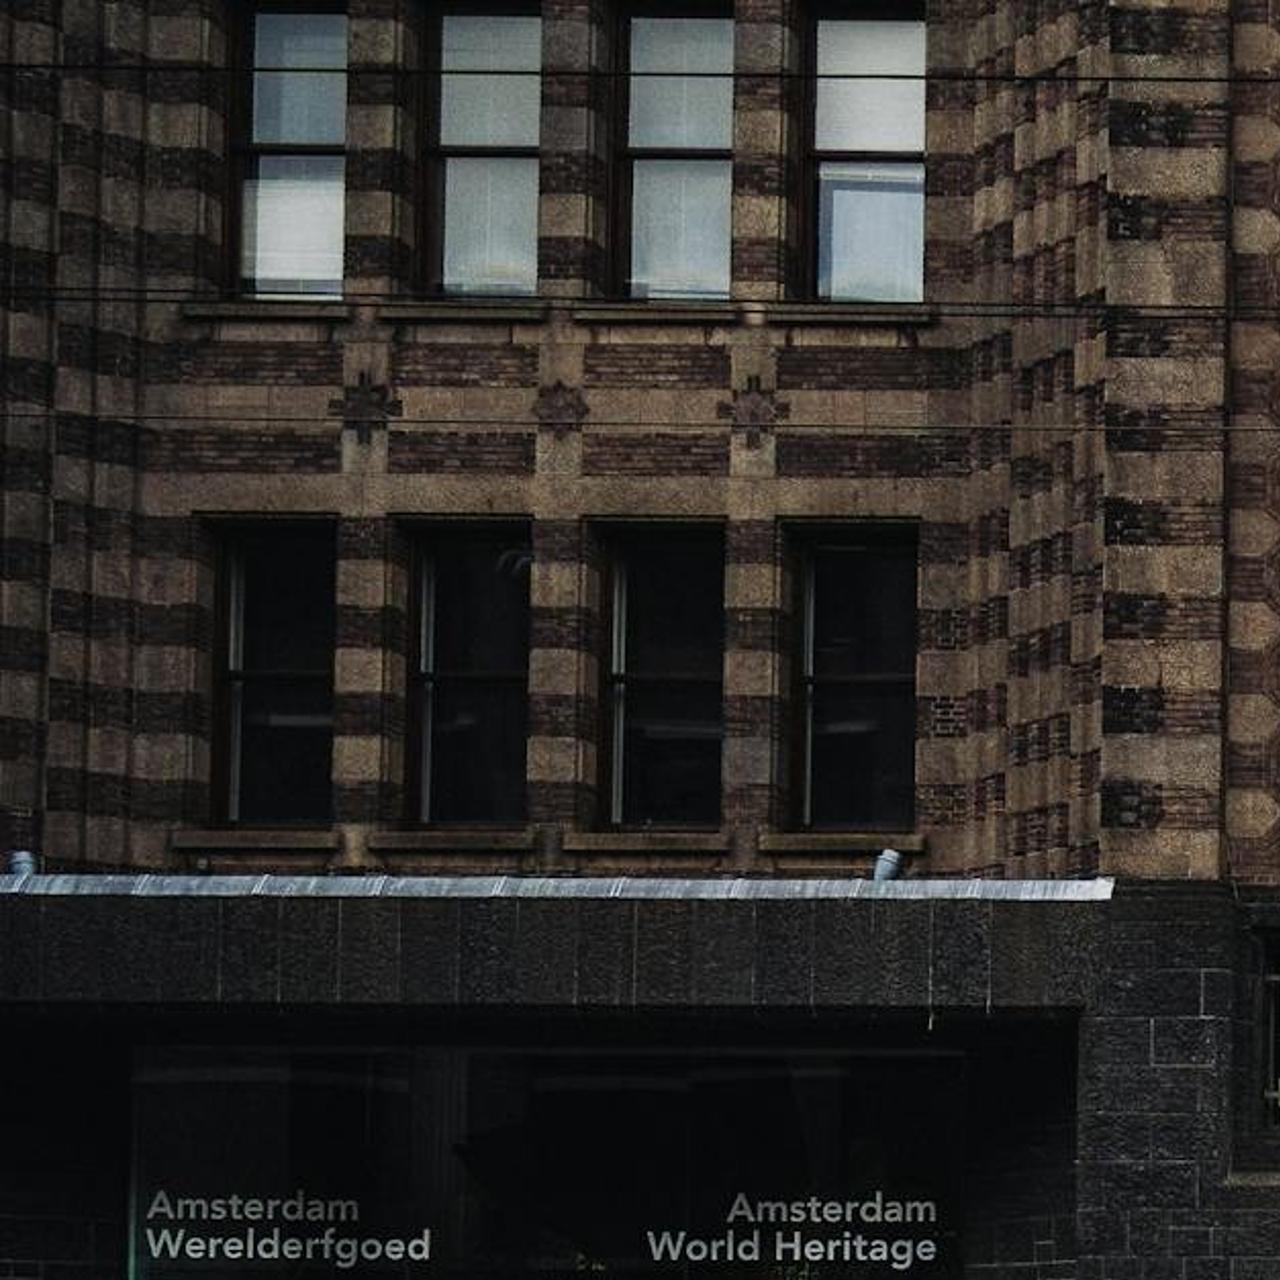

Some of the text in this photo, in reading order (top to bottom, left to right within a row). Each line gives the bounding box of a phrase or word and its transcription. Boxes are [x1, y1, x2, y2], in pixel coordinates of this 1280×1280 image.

[146, 1190, 361, 1222] Amsterdam
[728, 1191, 937, 1223] Amsterdam
[145, 1227, 432, 1267] Werelderfgoed
[647, 1229, 938, 1270] World Heritage
